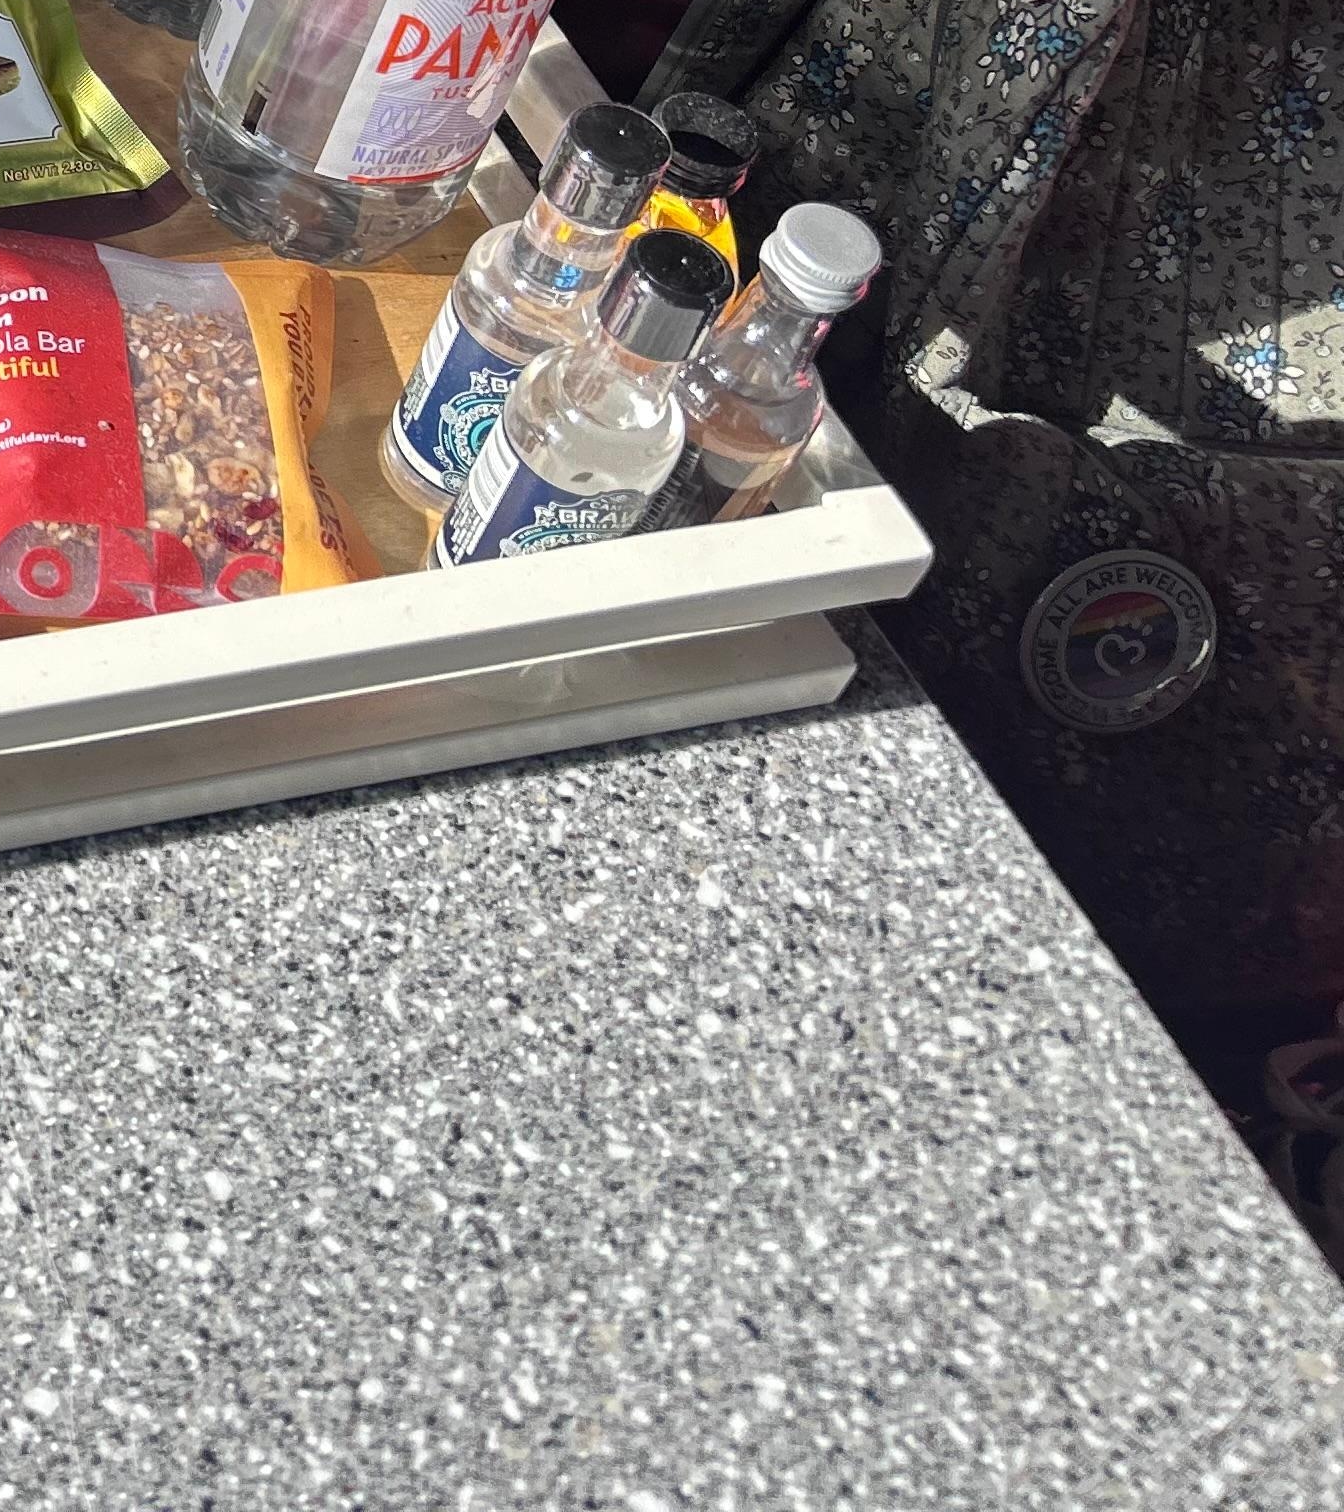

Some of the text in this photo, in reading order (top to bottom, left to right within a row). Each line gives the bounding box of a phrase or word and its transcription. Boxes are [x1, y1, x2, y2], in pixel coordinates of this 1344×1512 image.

[352, 145, 429, 164] NATURAL
[3, 168, 29, 186] Net
[37, 330, 86, 354] Bar
[1047, 567, 1128, 630] ALL ARE
